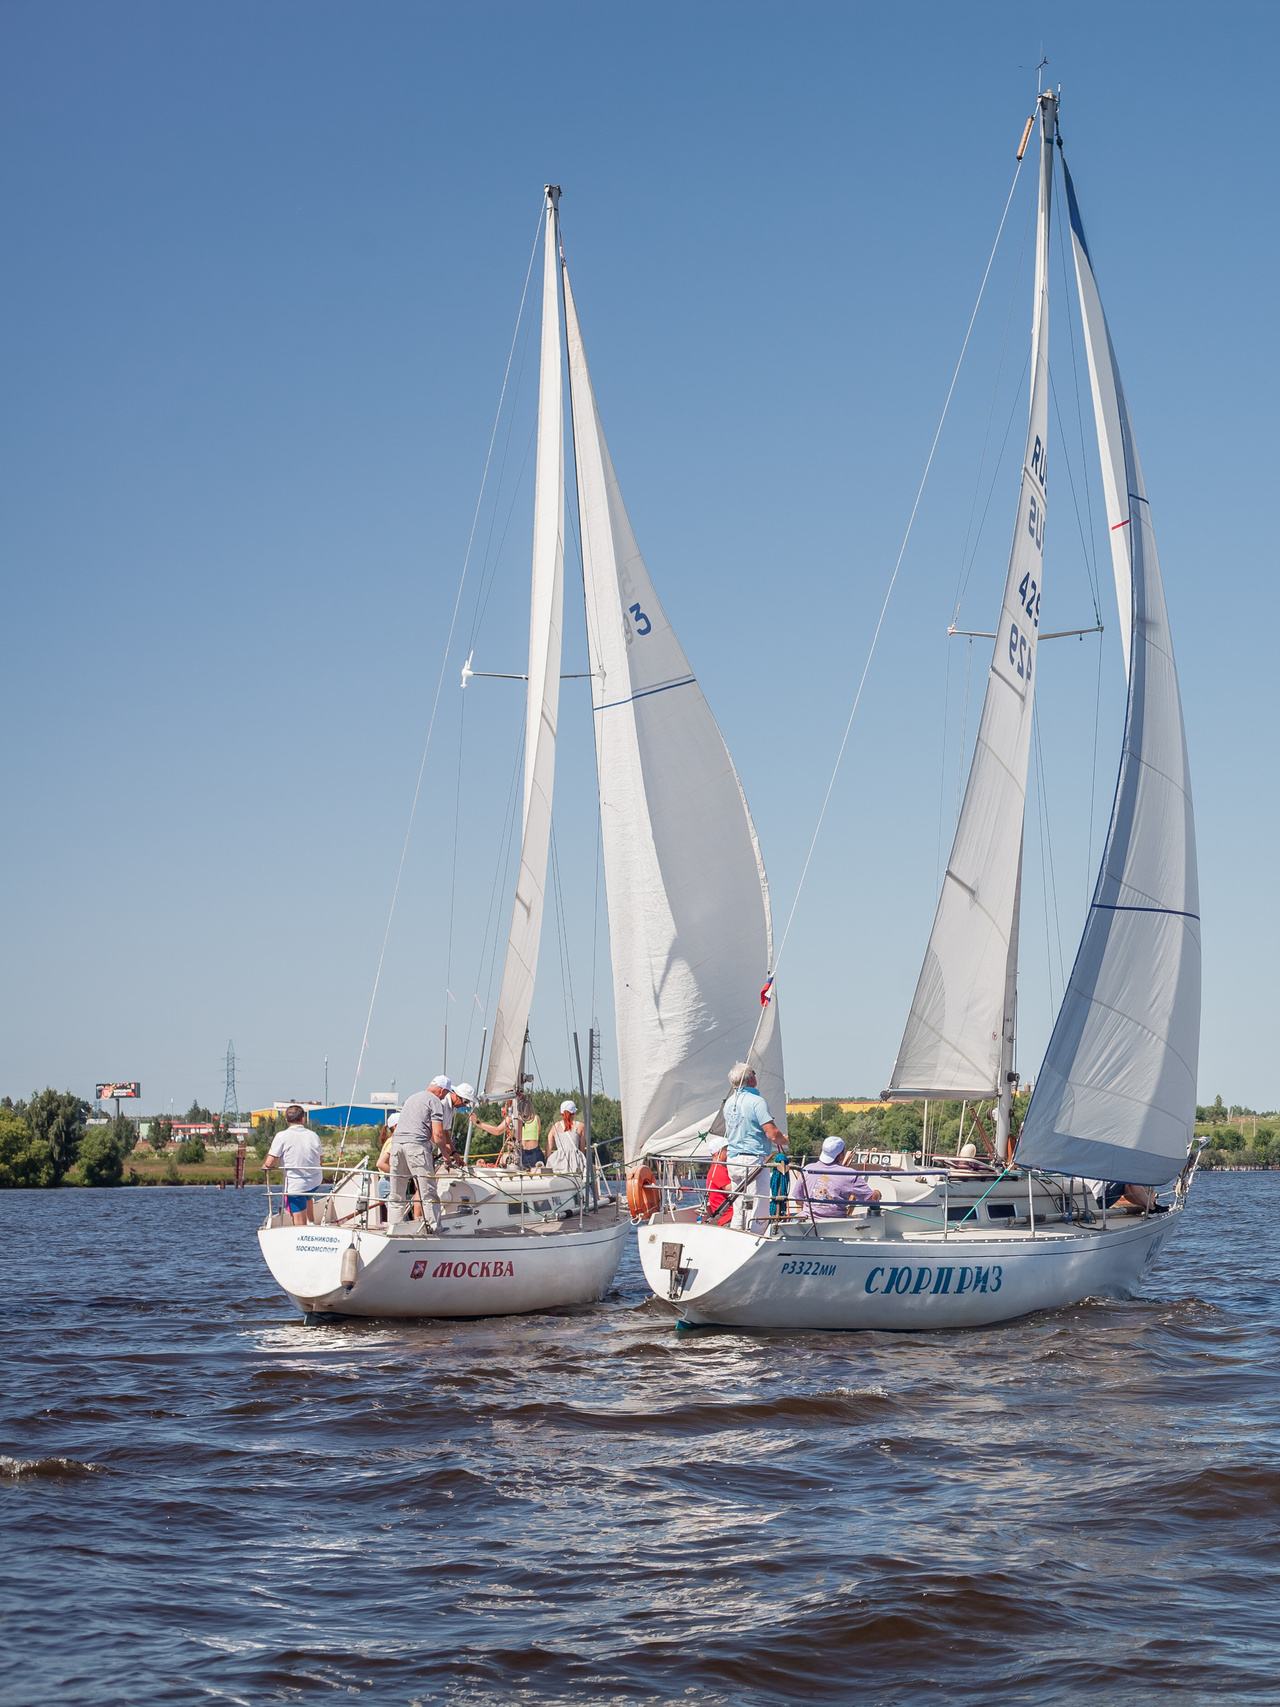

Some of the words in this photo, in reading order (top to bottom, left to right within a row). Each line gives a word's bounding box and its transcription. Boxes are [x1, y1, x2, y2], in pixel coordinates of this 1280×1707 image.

[1031, 434, 1047, 497] RU
[432, 1260, 514, 1278] МОСКВА
[864, 1265, 1003, 1295] СЮРПРИЗ
